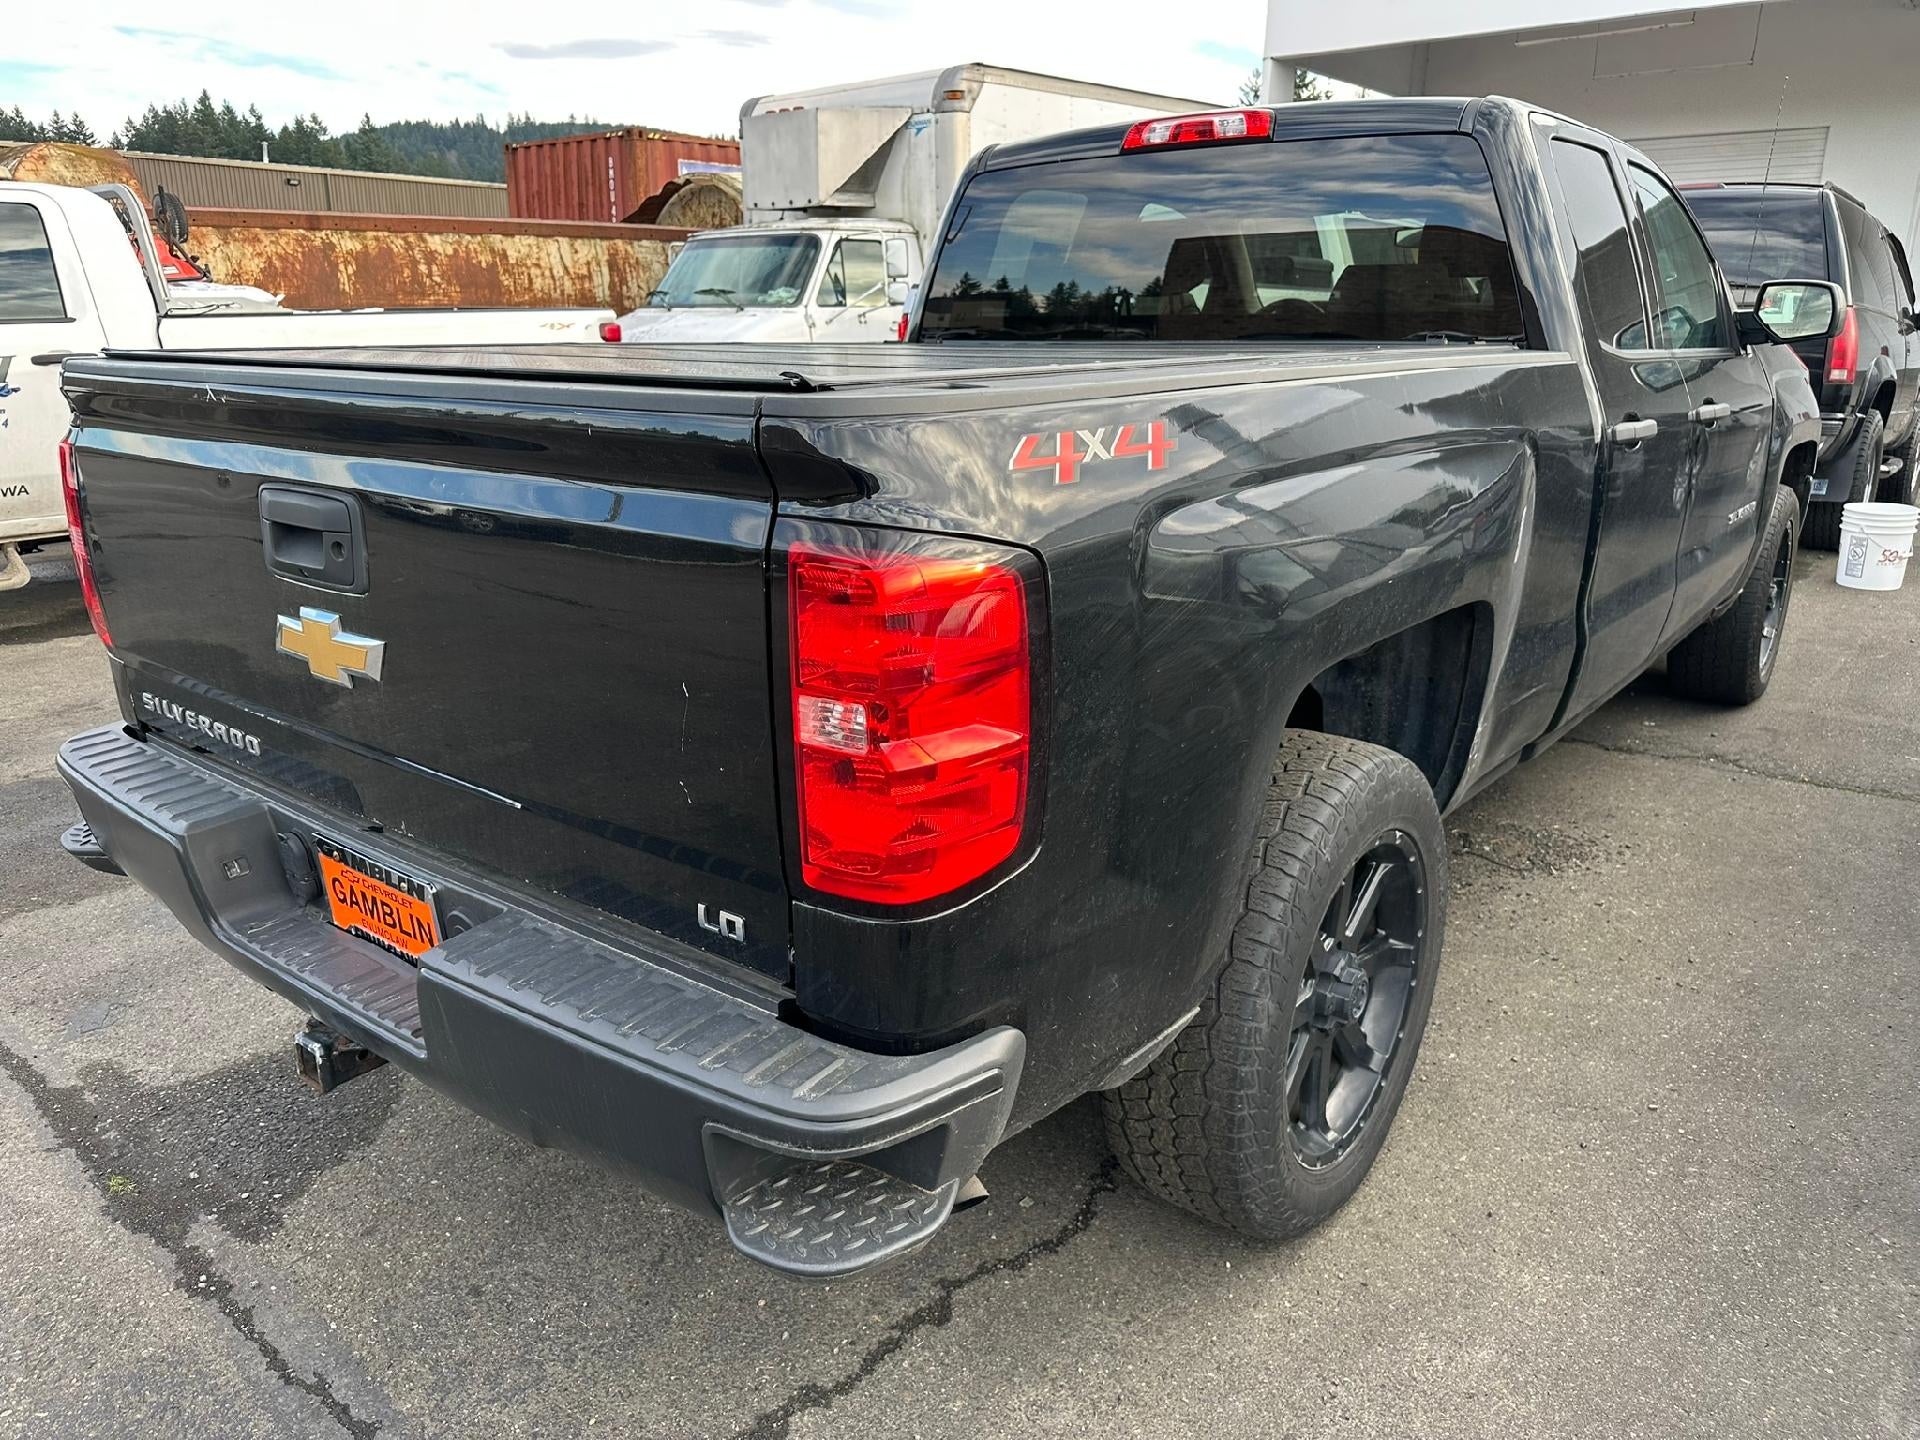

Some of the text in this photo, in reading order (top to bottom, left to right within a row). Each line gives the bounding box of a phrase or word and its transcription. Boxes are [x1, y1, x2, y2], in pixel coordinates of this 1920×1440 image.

[142, 692, 261, 757] SILVERADO
[331, 876, 436, 948] GAMBLIN
[361, 879, 414, 909] CHEVROLET
